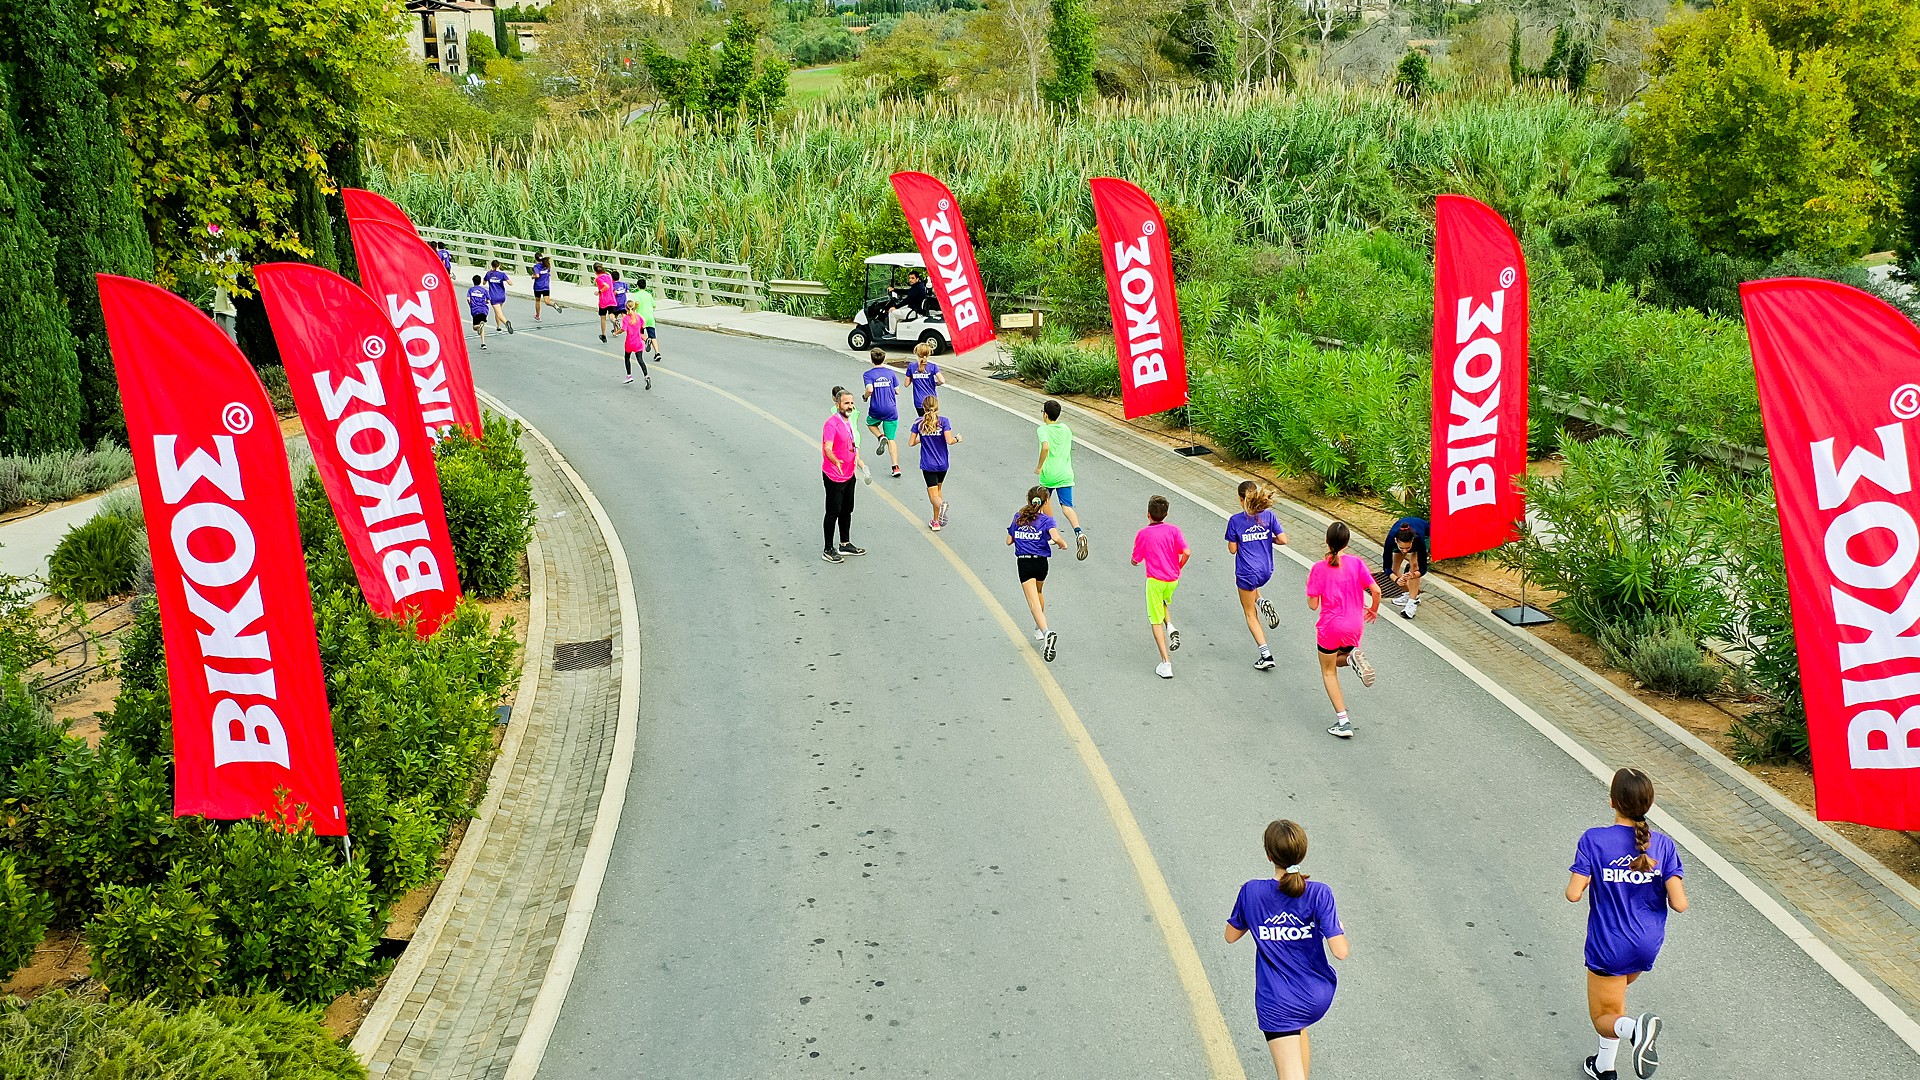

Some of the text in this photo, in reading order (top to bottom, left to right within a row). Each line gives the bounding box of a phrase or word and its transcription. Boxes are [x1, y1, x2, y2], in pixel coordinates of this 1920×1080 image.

[920, 211, 979, 331] ΒΙΚΟΣ
[1115, 236, 1167, 389] ΒΙΚΟΣ
[1448, 290, 1504, 516] ΒΙΚΟΣ
[313, 361, 444, 604] ΒΙΚΟΣ
[1014, 530, 1041, 540] ΒΙΚΟΣ
[1242, 532, 1269, 542] ΒΙΚΟΣ
[154, 435, 290, 770] ΒΙΚΟΣ
[1810, 422, 1920, 770] ΒΙΚΟΣ
[1258, 924, 1314, 941] ΒΙΚΟΣ
[1601, 867, 1655, 884] ΒΙΚΟΣ
